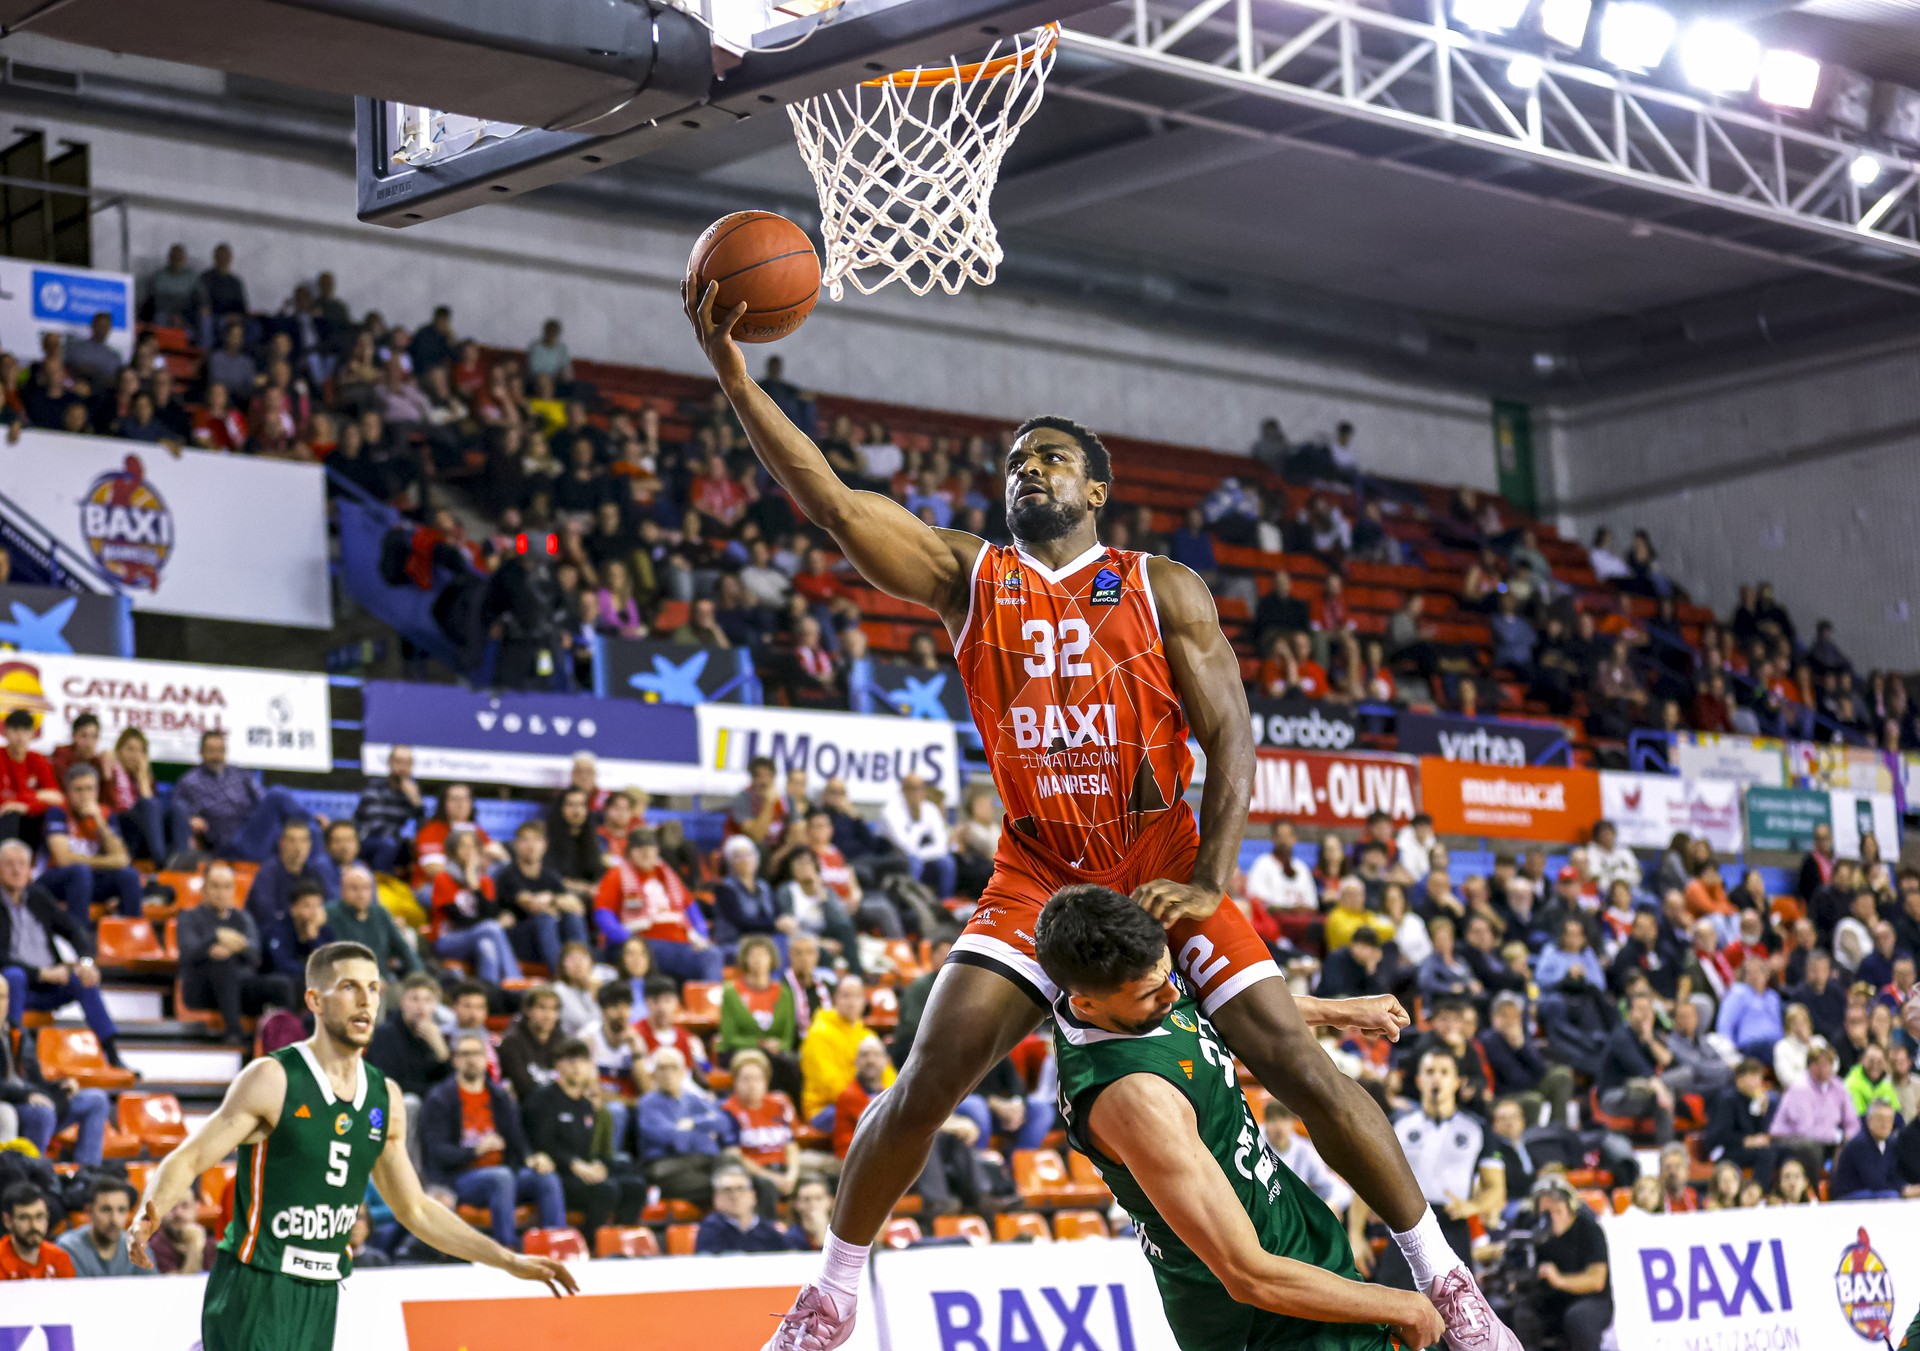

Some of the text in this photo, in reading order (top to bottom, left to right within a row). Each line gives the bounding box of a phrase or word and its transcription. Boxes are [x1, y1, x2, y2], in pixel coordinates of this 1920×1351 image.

[86, 504, 169, 544] BAXI
[1021, 618, 1092, 678] 32
[63, 677, 226, 707] CATALANA
[111, 705, 230, 735] TREBALL
[475, 710, 598, 738] VOLVO
[1010, 704, 1118, 749] BAXI
[1019, 748, 1119, 769] CLIMATIZACIÓN
[1036, 773, 1113, 799] MANRESA
[325, 1140, 351, 1187] 5
[1638, 1238, 1792, 1322] BAXI
[1836, 1270, 1893, 1304] BAXI
[929, 1283, 1137, 1351] BAXI
